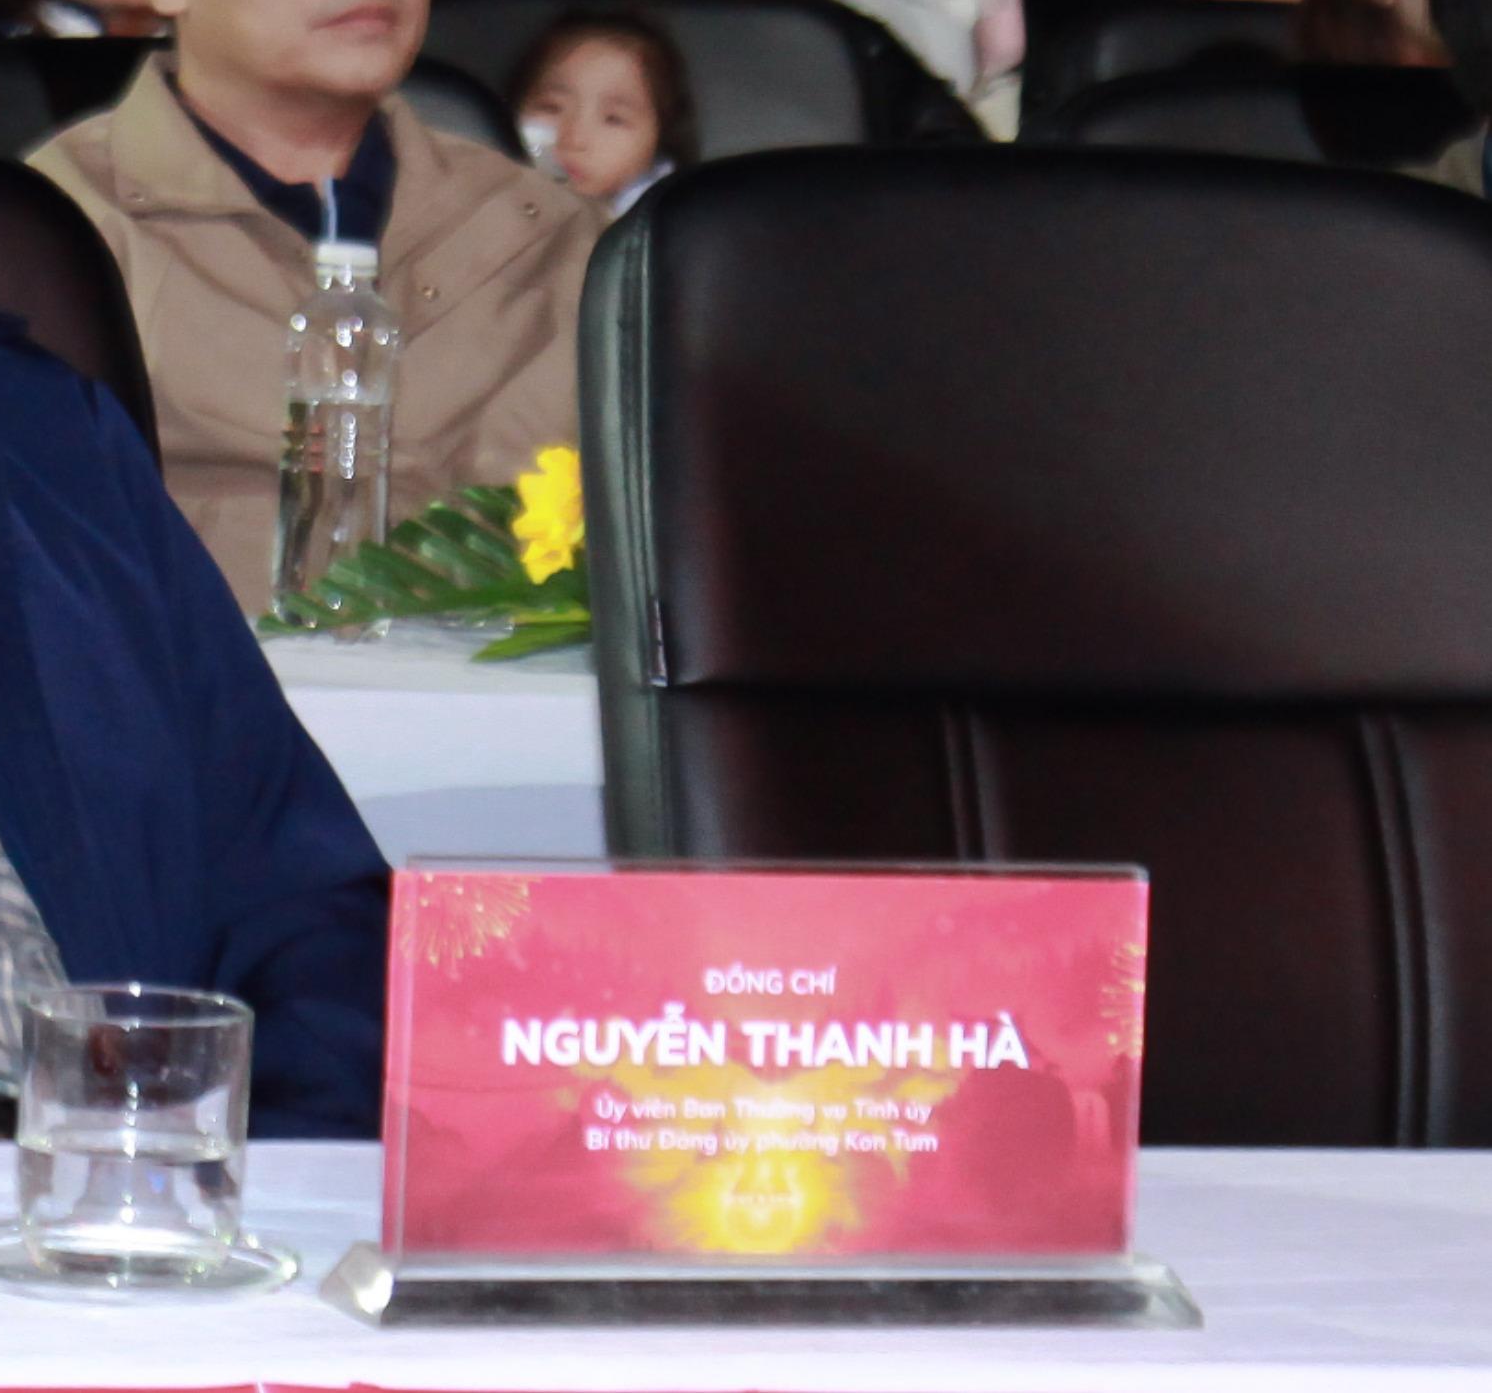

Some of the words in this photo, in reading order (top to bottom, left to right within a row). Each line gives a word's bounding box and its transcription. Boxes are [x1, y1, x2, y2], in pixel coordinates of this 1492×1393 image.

[791, 965, 837, 995] CHÍ
[502, 1002, 726, 1067] NGUYỄN
[741, 1020, 933, 1068] THANH
[948, 1011, 1029, 1069] HÀ
